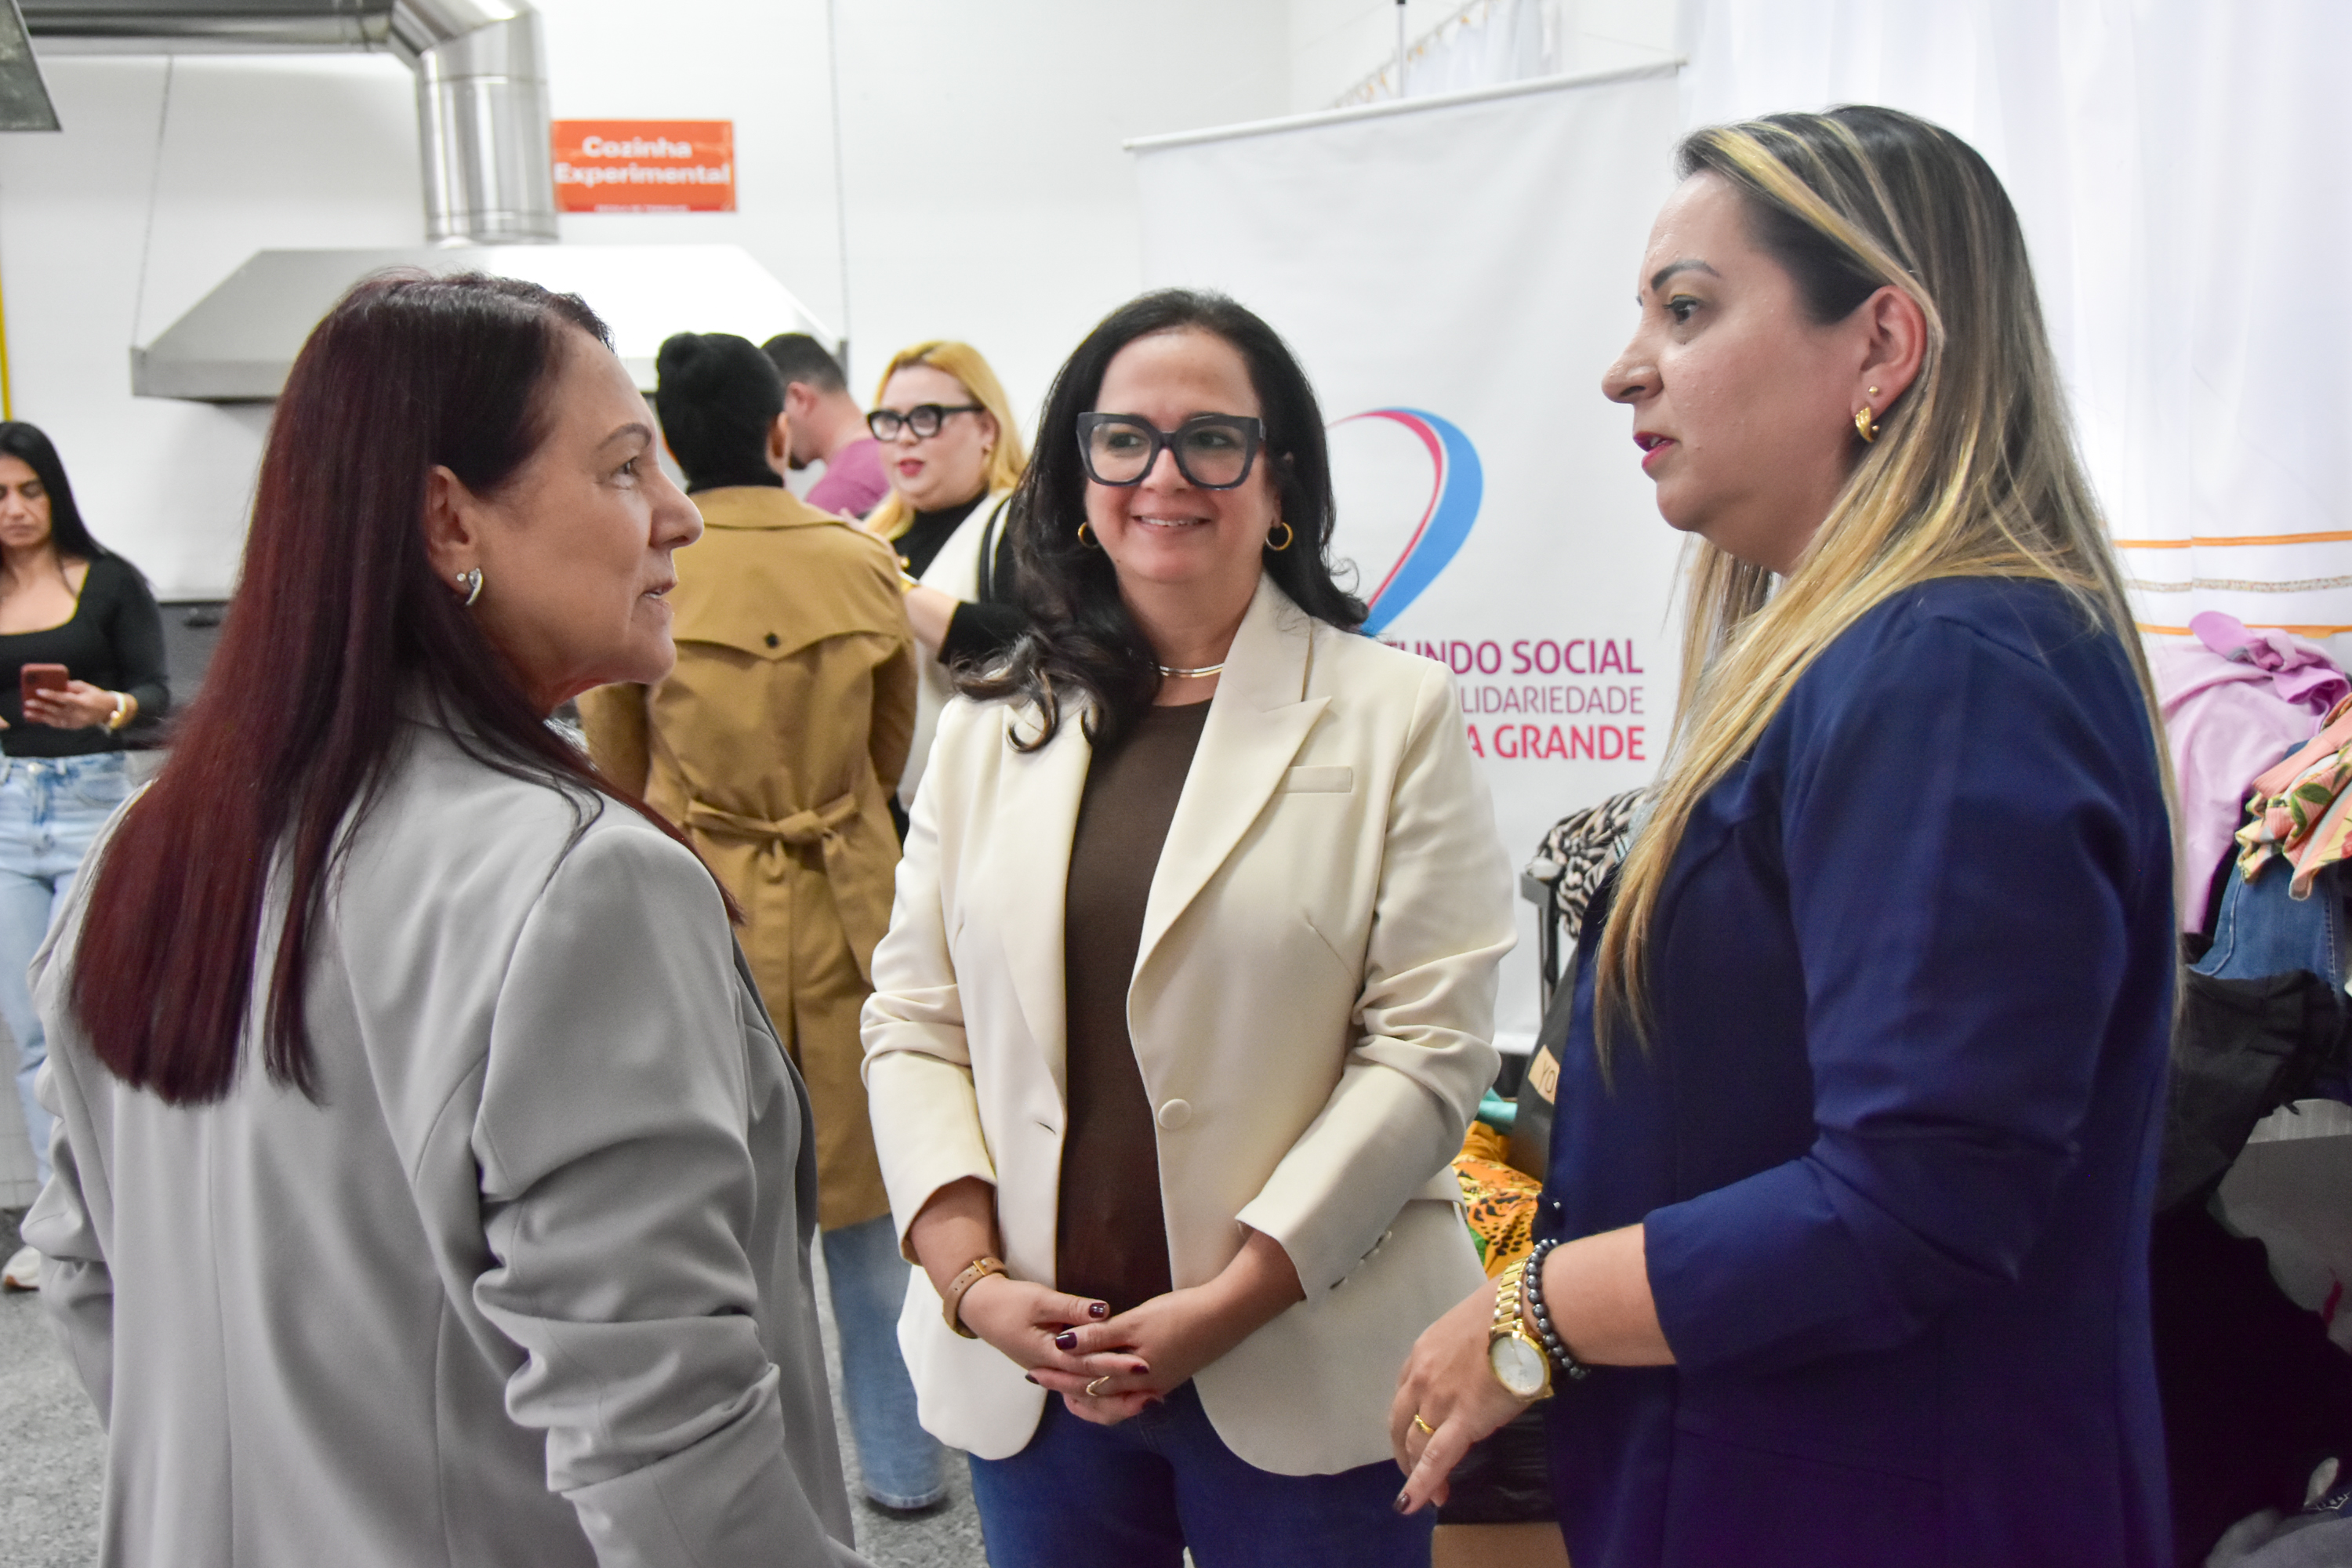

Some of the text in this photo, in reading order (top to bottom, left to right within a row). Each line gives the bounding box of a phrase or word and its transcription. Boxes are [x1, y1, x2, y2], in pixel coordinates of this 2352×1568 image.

[582, 135, 692, 159] Cozinha
[554, 162, 731, 187] Experimental
[1384, 639, 1644, 674] NDO SOCIAL
[1461, 685, 1644, 714] LIDARIEDADE
[1494, 724, 1646, 761] GRANDE
